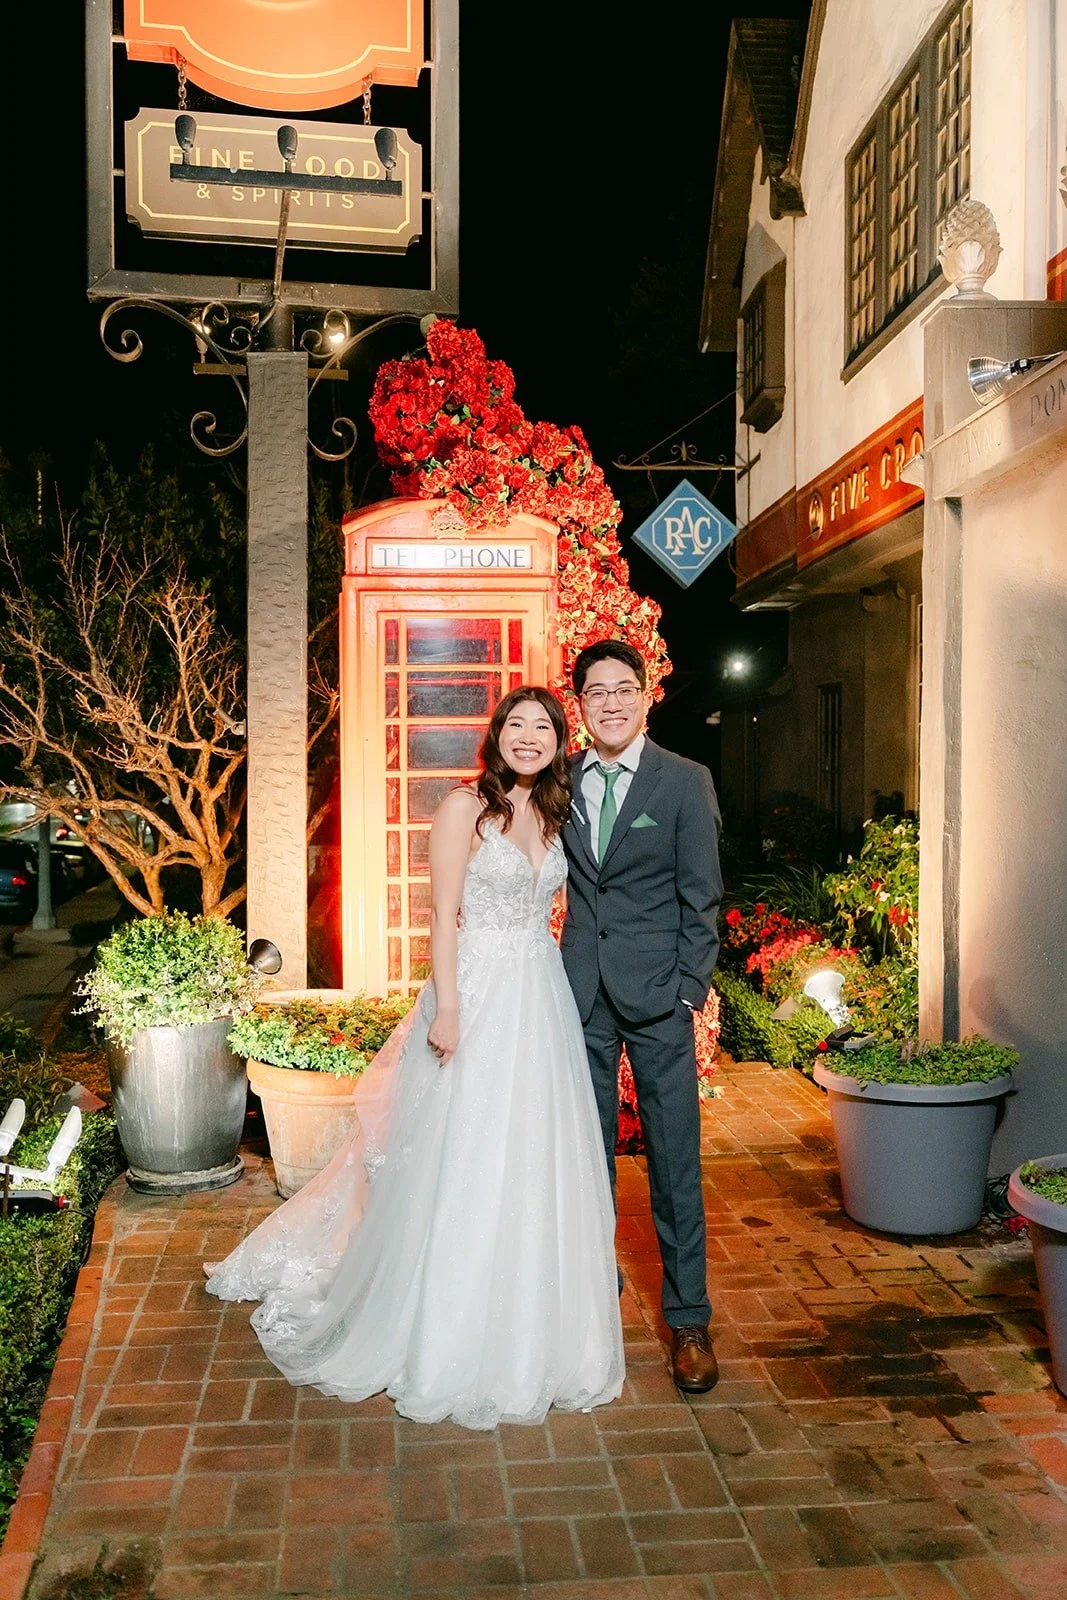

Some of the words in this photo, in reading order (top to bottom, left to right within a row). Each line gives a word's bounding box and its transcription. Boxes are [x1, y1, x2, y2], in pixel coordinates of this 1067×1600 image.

[169, 145, 255, 171] FINE
[196, 183, 211, 200] &
[231, 184, 355, 209] SPIRITS
[830, 465, 870, 522] FIVE
[664, 506, 712, 555] RAC
[378, 547, 526, 568] TEPHONE
